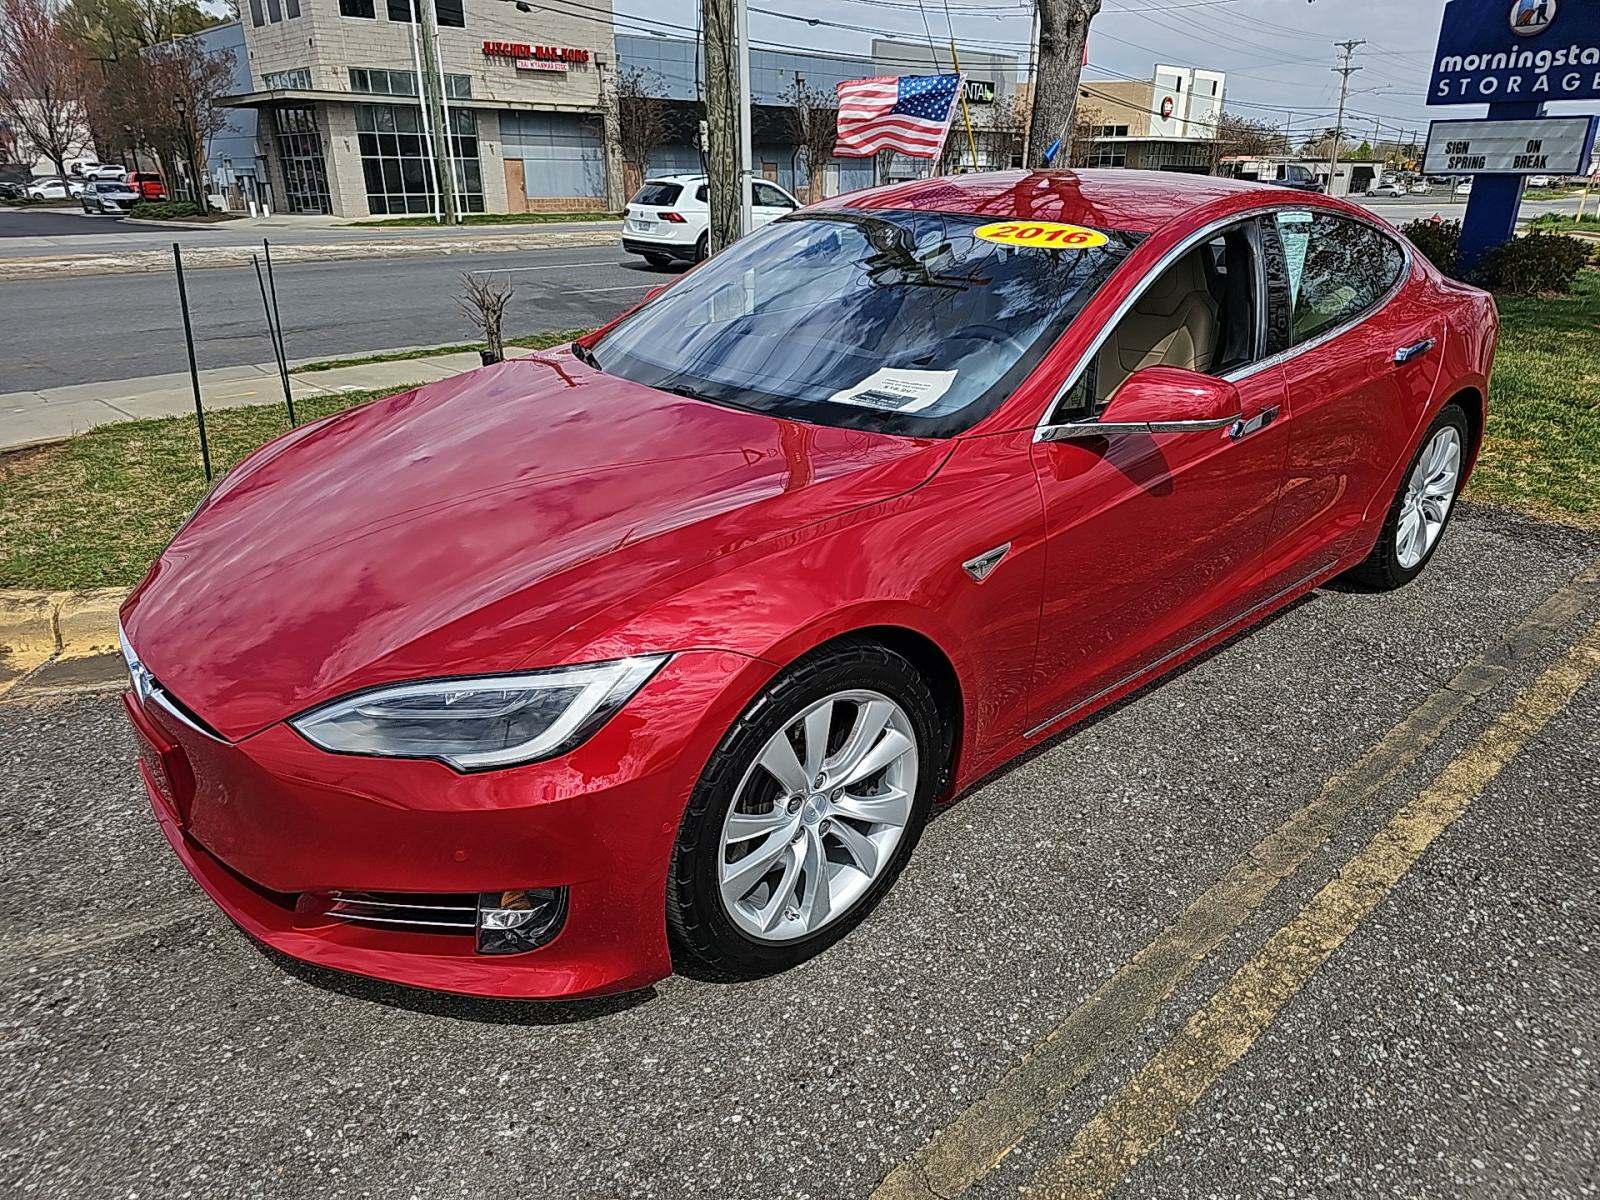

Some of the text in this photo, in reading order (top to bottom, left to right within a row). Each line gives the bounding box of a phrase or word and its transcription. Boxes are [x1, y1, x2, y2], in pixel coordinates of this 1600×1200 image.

[483, 41, 531, 58] KITCHEN
[561, 47, 590, 63] KONG
[1445, 139, 1542, 154] SIGN ON
[1447, 154, 1549, 169] SPRING BREAK
[986, 226, 1094, 244] 2016
